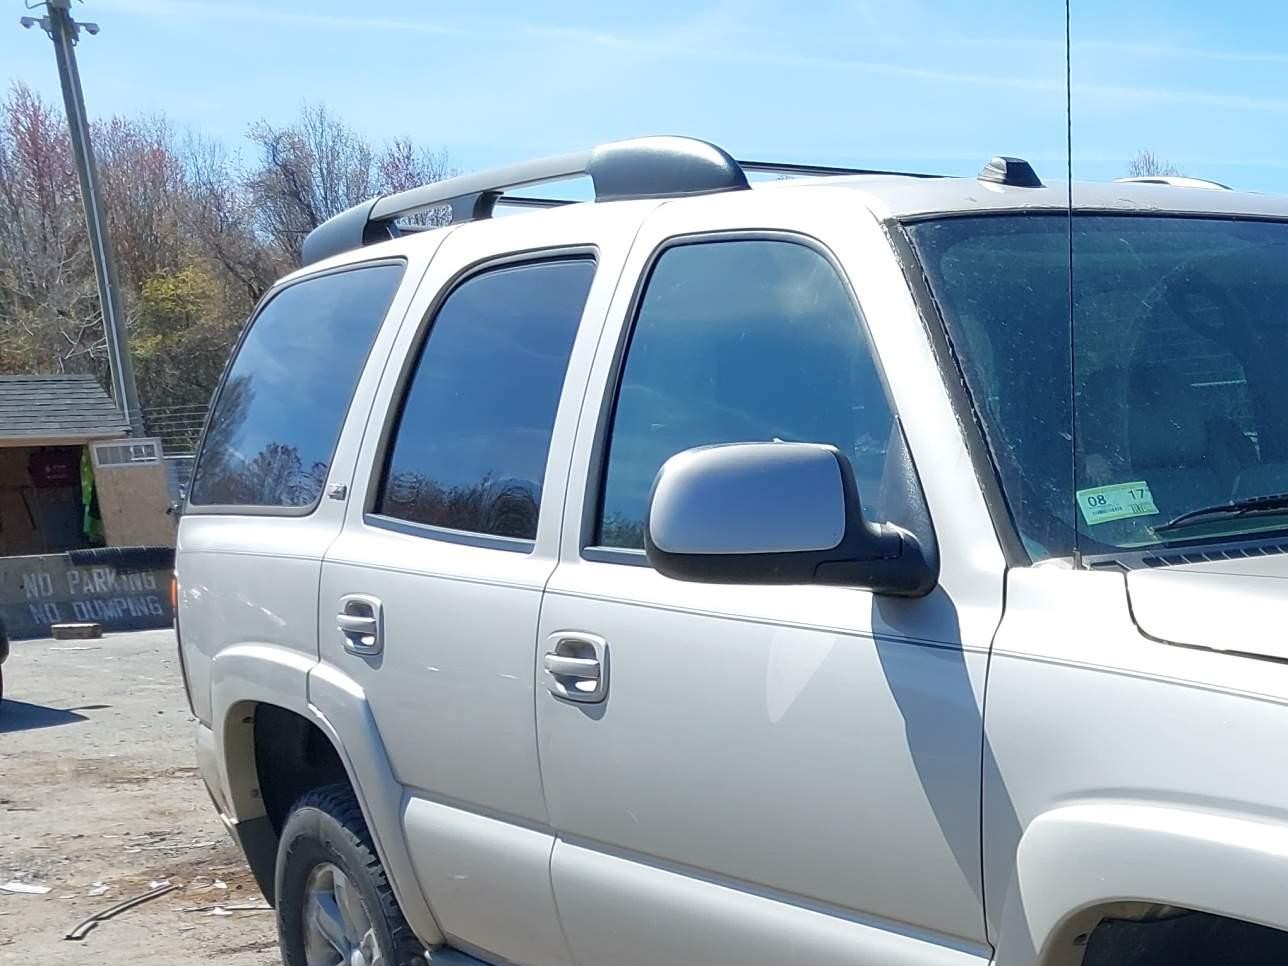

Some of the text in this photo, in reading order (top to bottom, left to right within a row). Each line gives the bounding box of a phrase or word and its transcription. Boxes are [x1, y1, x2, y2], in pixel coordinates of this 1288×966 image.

[1087, 488, 1144, 507] 08 17
[23, 571, 54, 598] NO
[29, 595, 164, 625] NO DUMPING
